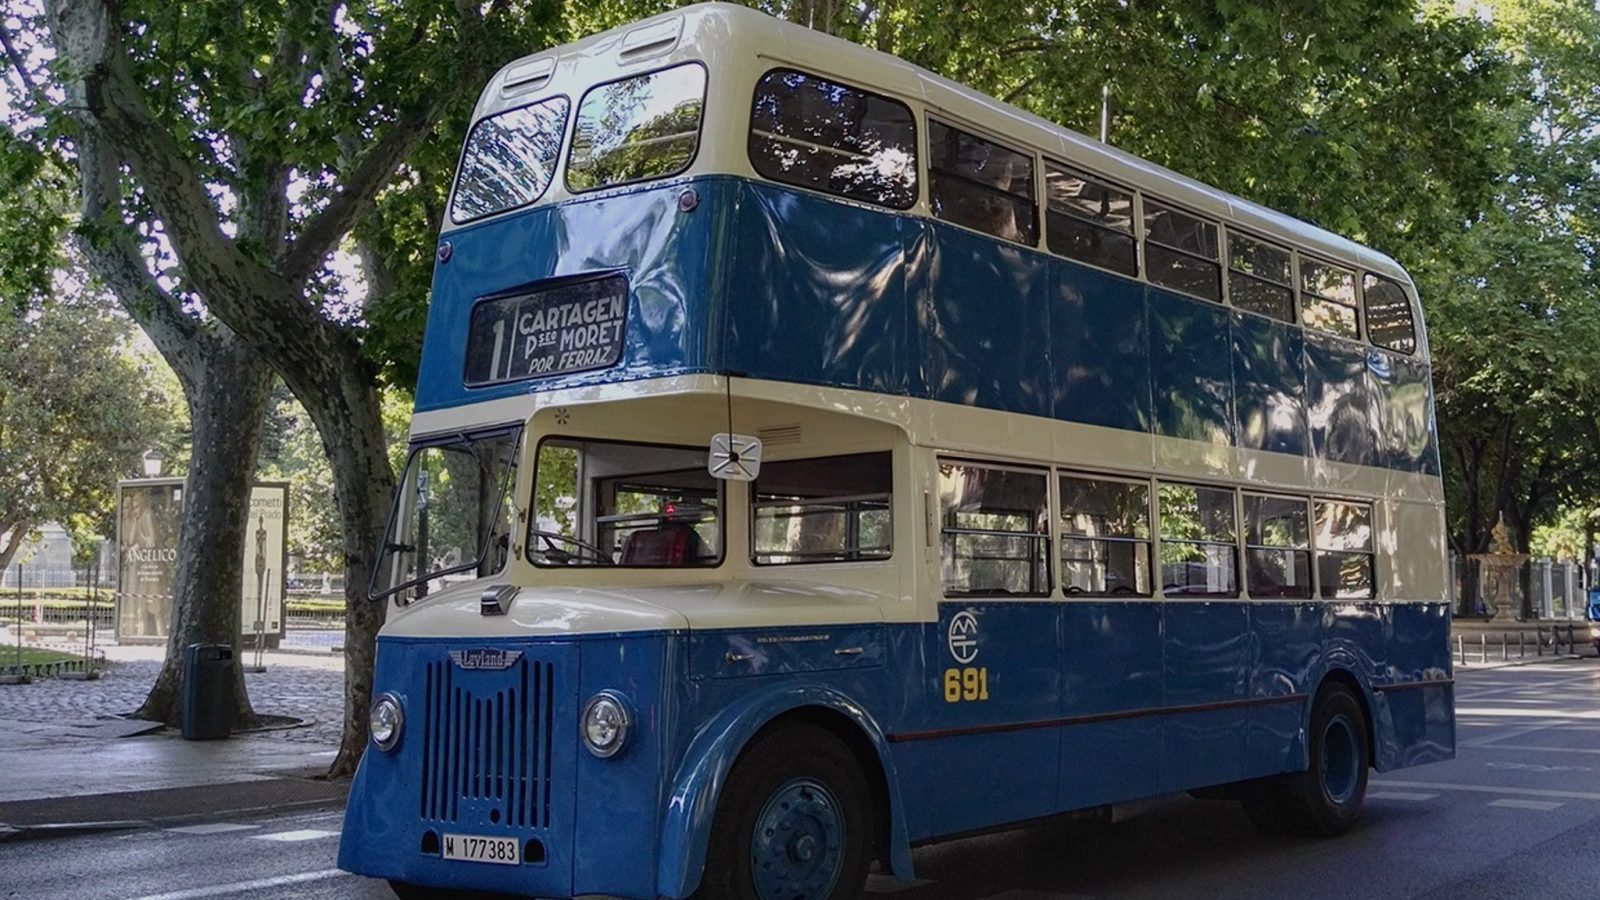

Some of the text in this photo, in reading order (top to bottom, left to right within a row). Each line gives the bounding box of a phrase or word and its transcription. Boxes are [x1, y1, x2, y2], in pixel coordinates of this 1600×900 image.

[519, 294, 625, 336] CARTAGEN
[489, 319, 505, 381] 1
[559, 320, 624, 352] MORET
[528, 346, 612, 374] POR FERRAZ
[127, 548, 177, 562] ANGELICO
[463, 650, 504, 668] Leyland
[944, 667, 989, 702] 691
[445, 836, 516, 861] M 177383
